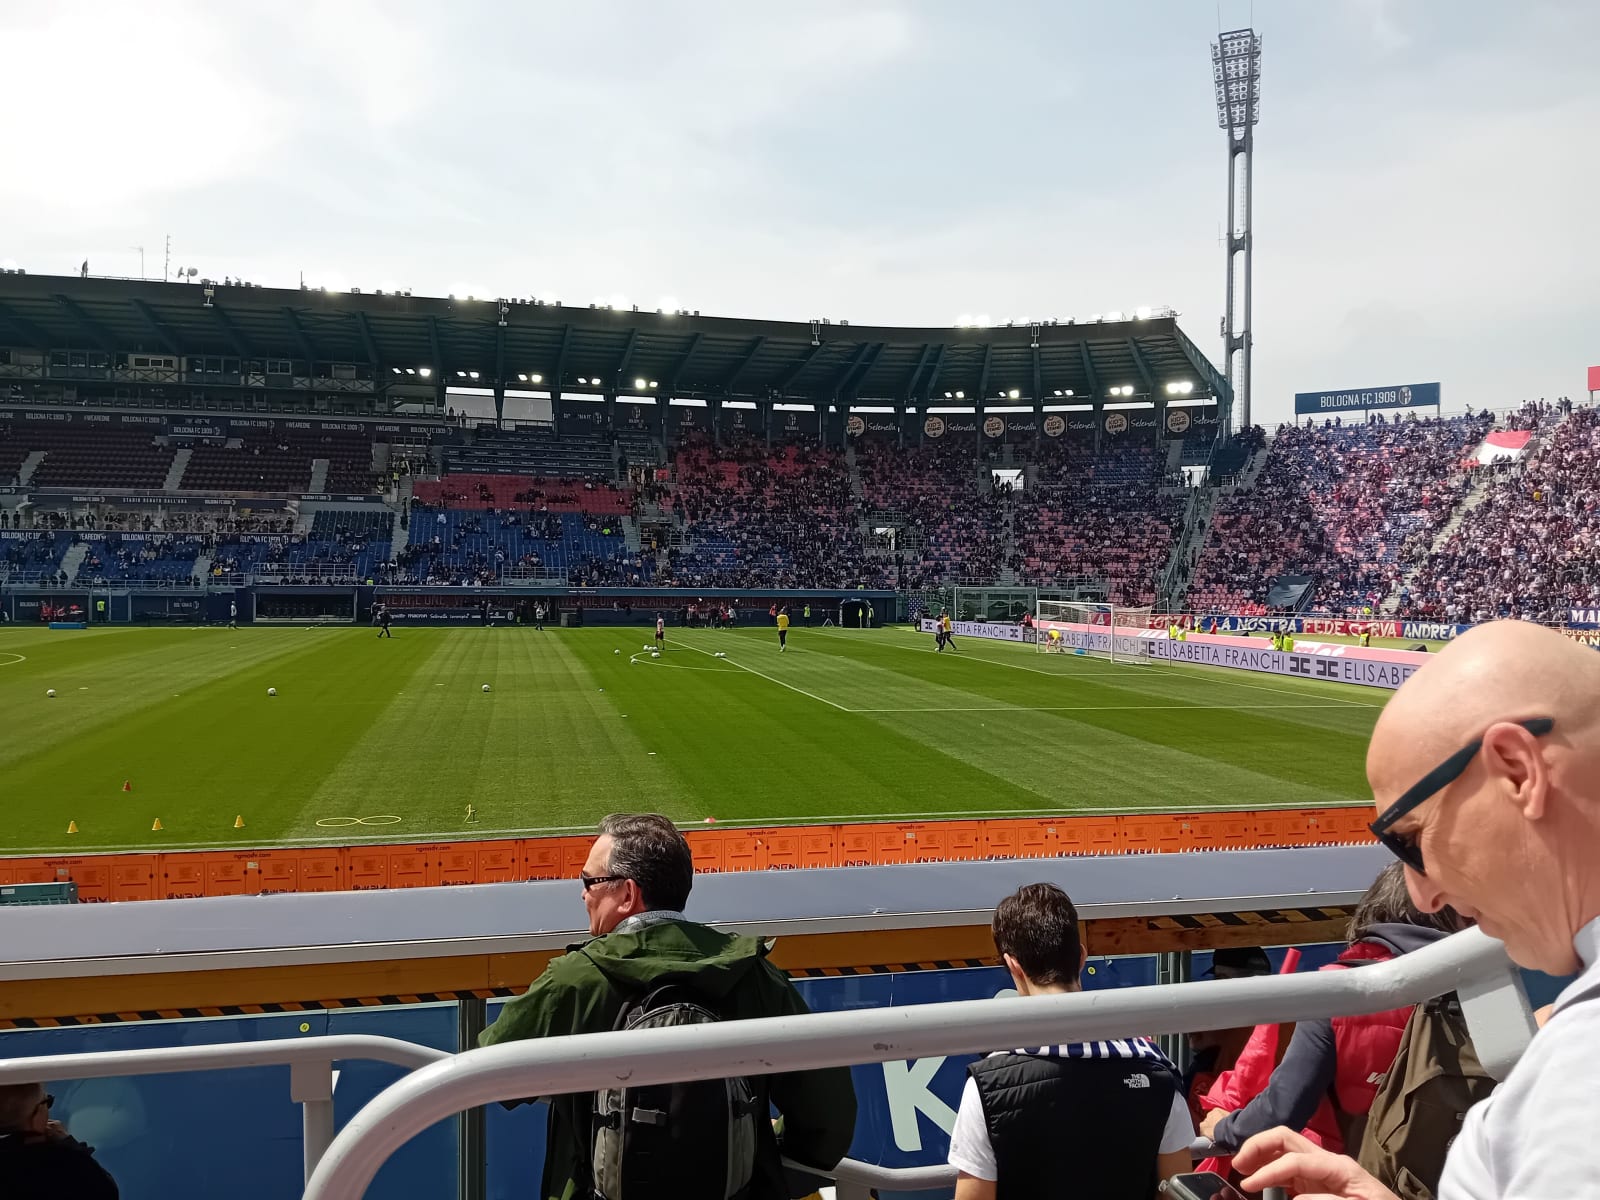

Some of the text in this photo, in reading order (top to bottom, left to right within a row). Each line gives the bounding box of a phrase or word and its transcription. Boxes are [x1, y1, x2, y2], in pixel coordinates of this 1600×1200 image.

[1320, 391, 1393, 407] BOLOGNA FC 1909
[867, 422, 896, 431] Selenella
[947, 423, 976, 432] Selenella
[121, 533, 144, 541] BOLOGNA
[951, 622, 1007, 637] BETTA FRANCHI
[1145, 616, 1192, 630] FORZA
[1236, 618, 1297, 633] NOSTRA
[1302, 619, 1345, 636] FEDE
[1403, 624, 1457, 640] ANDREA
[1060, 631, 1139, 652] SABETTA FRANCHI
[1158, 642, 1220, 662] ELISABETTA
[1225, 648, 1285, 670] FRANCHI
[1344, 662, 1413, 686] ELISABE
